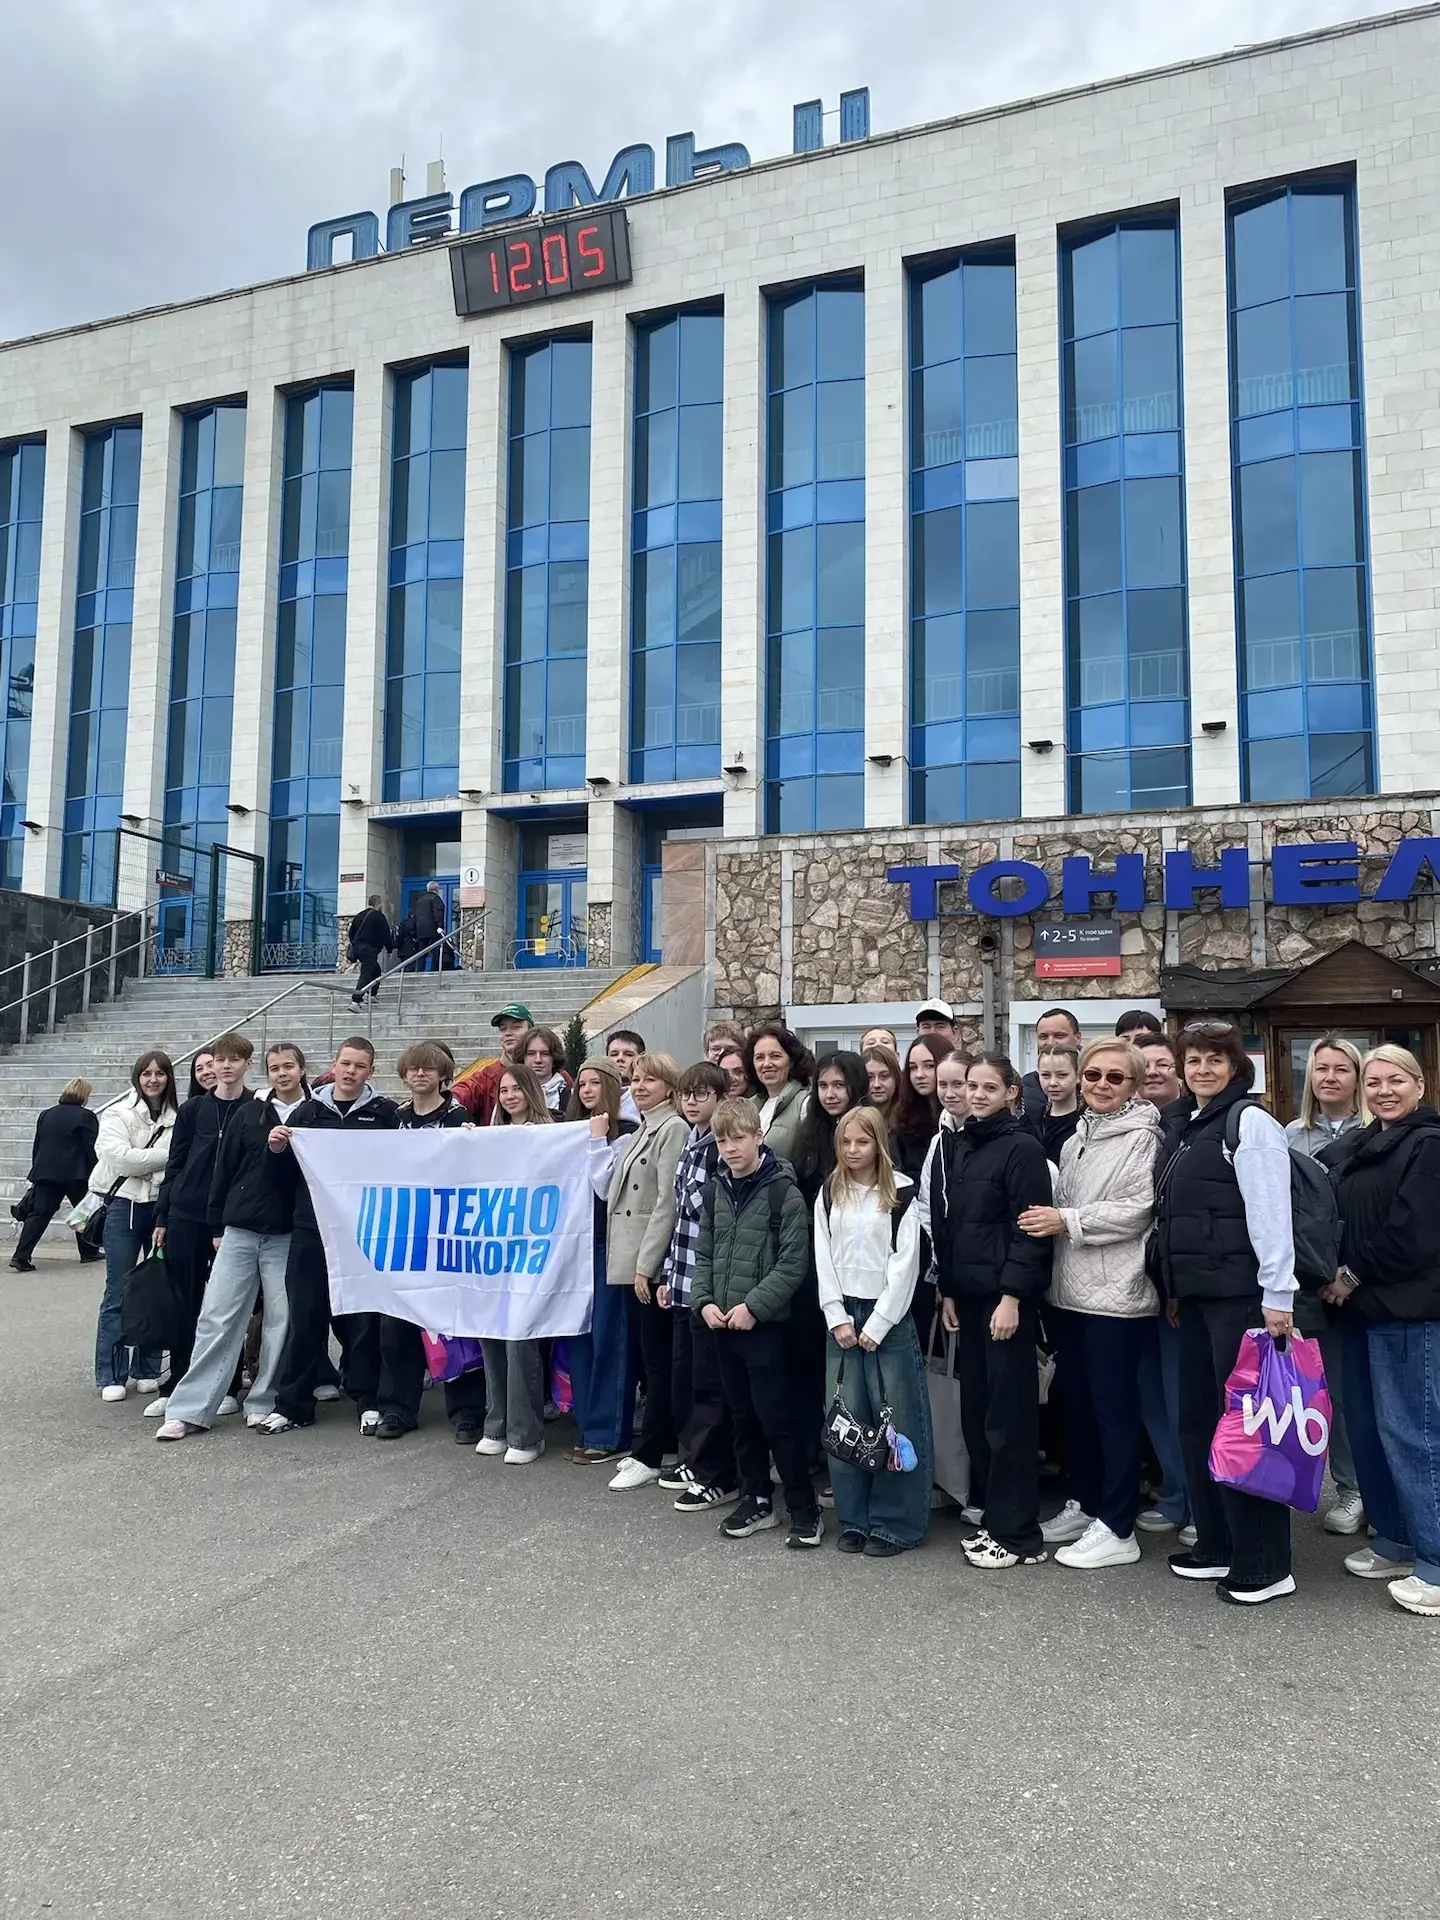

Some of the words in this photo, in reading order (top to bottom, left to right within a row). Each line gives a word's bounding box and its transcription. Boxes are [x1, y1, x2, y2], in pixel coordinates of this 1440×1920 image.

[307, 131, 751, 270] ПЕРМЬ
[489, 226, 605, 294] 12.05
[1052, 929, 1077, 943] 2-5
[433, 1185, 561, 1237] ТЕХНО
[1242, 1385, 1329, 1456] wb
